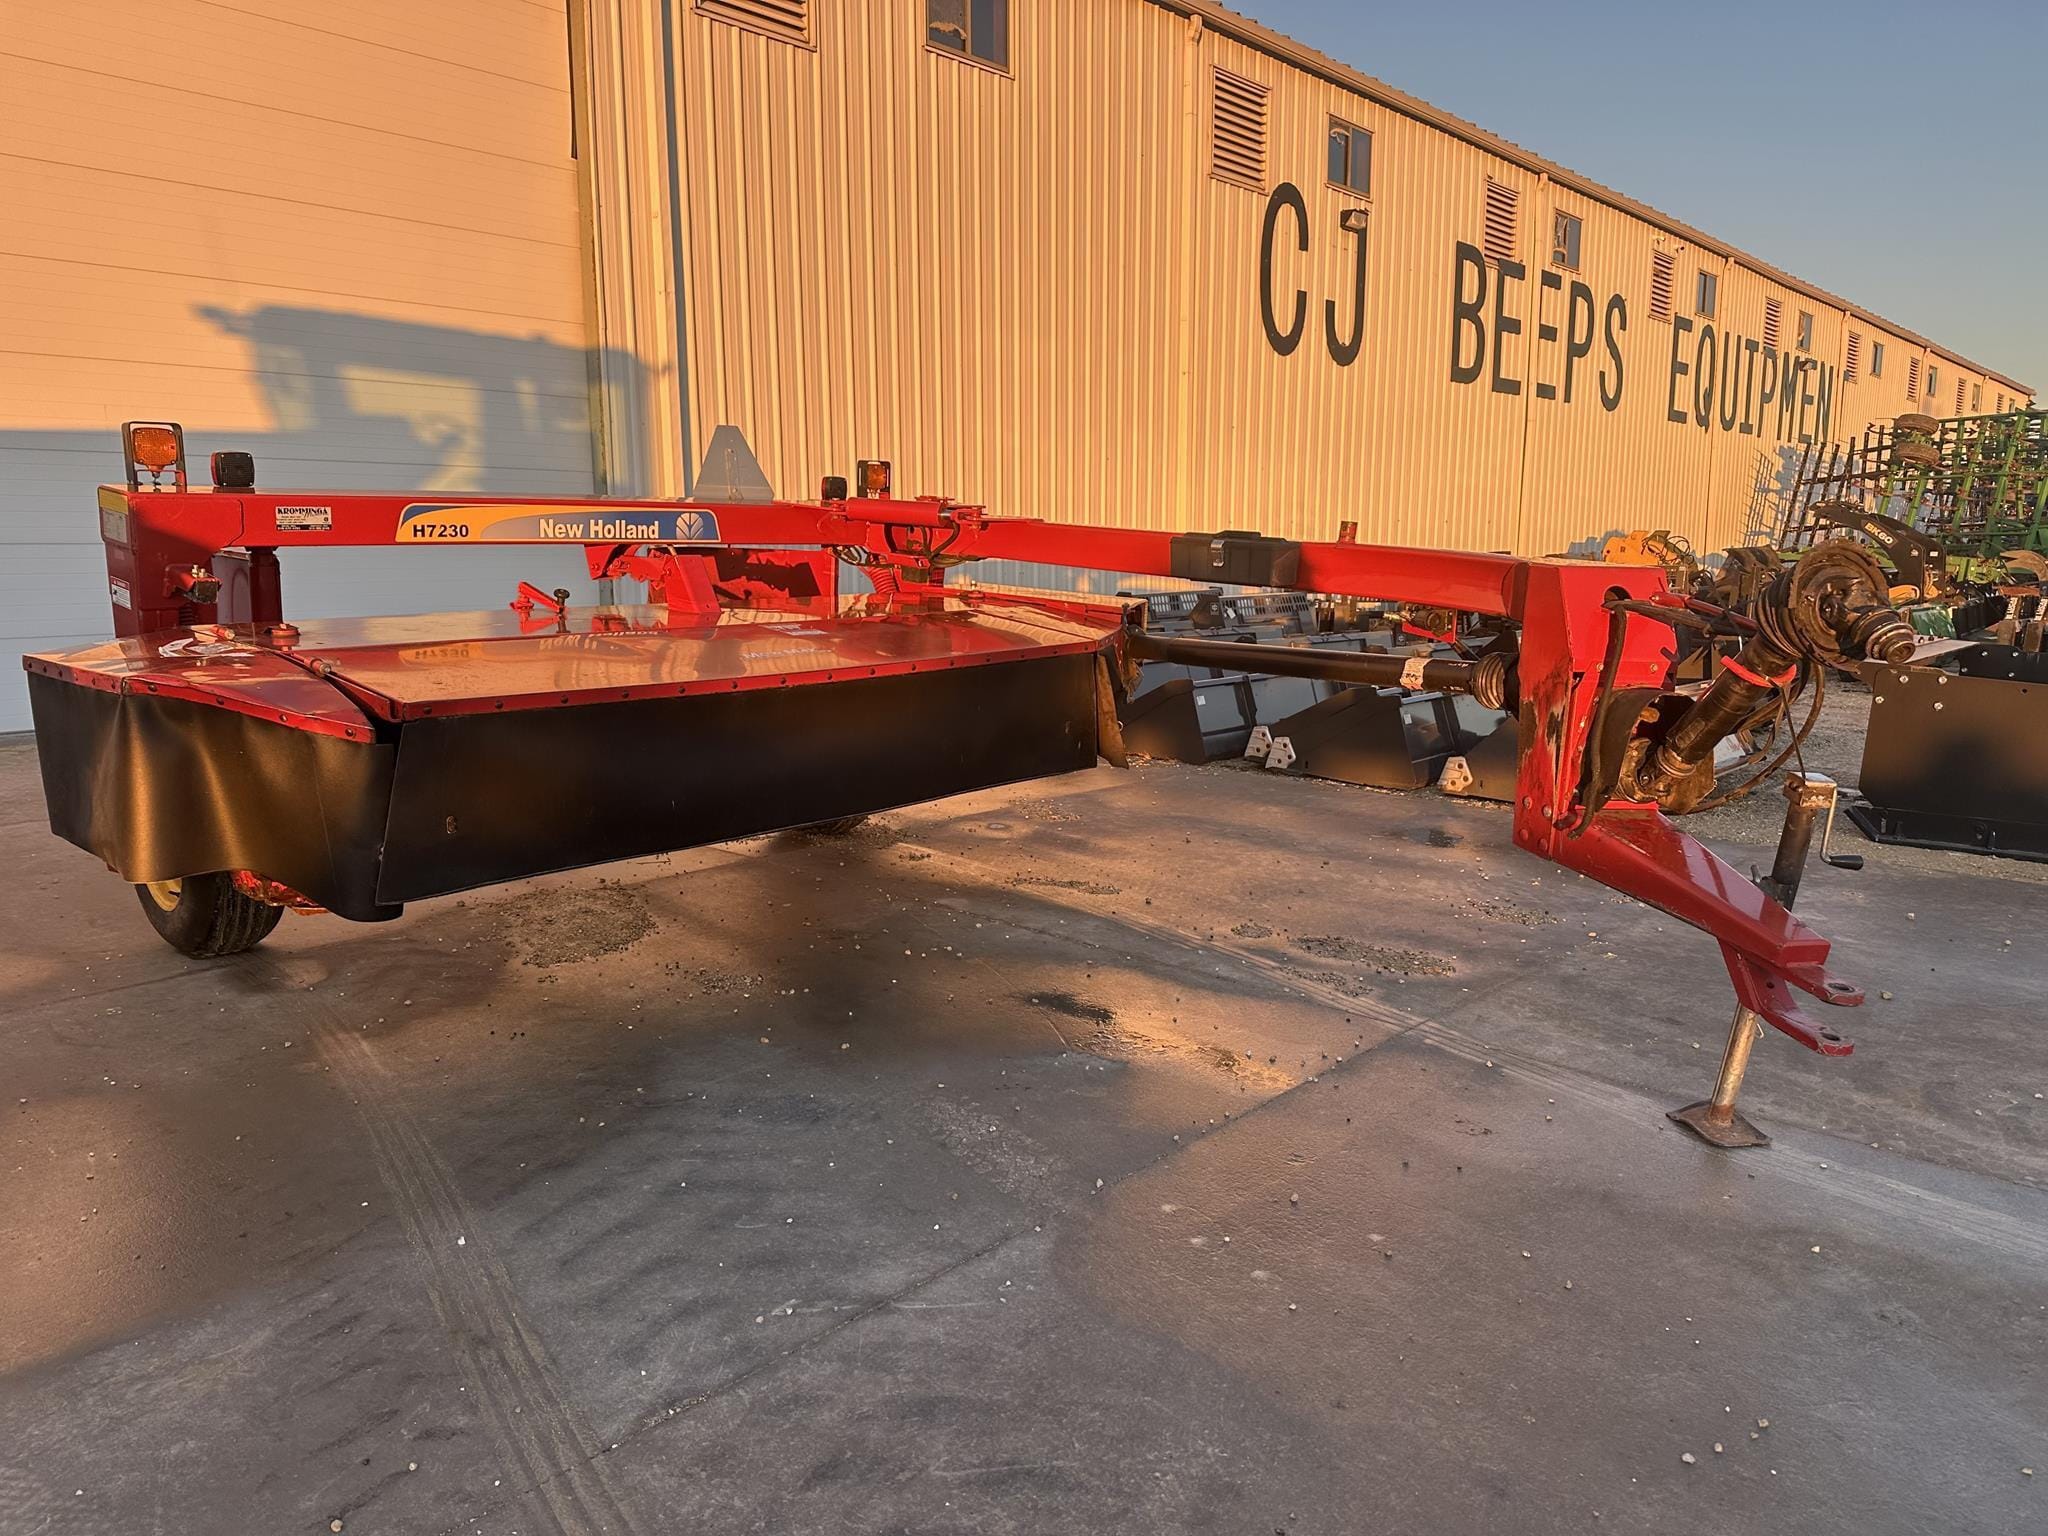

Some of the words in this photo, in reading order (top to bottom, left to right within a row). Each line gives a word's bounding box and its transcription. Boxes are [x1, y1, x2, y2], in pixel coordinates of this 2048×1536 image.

[1260, 182, 1369, 367] CJ
[1450, 240, 1628, 412] BEEPS
[413, 524, 469, 538] H7230
[539, 518, 582, 539] New
[590, 519, 660, 539] Holland
